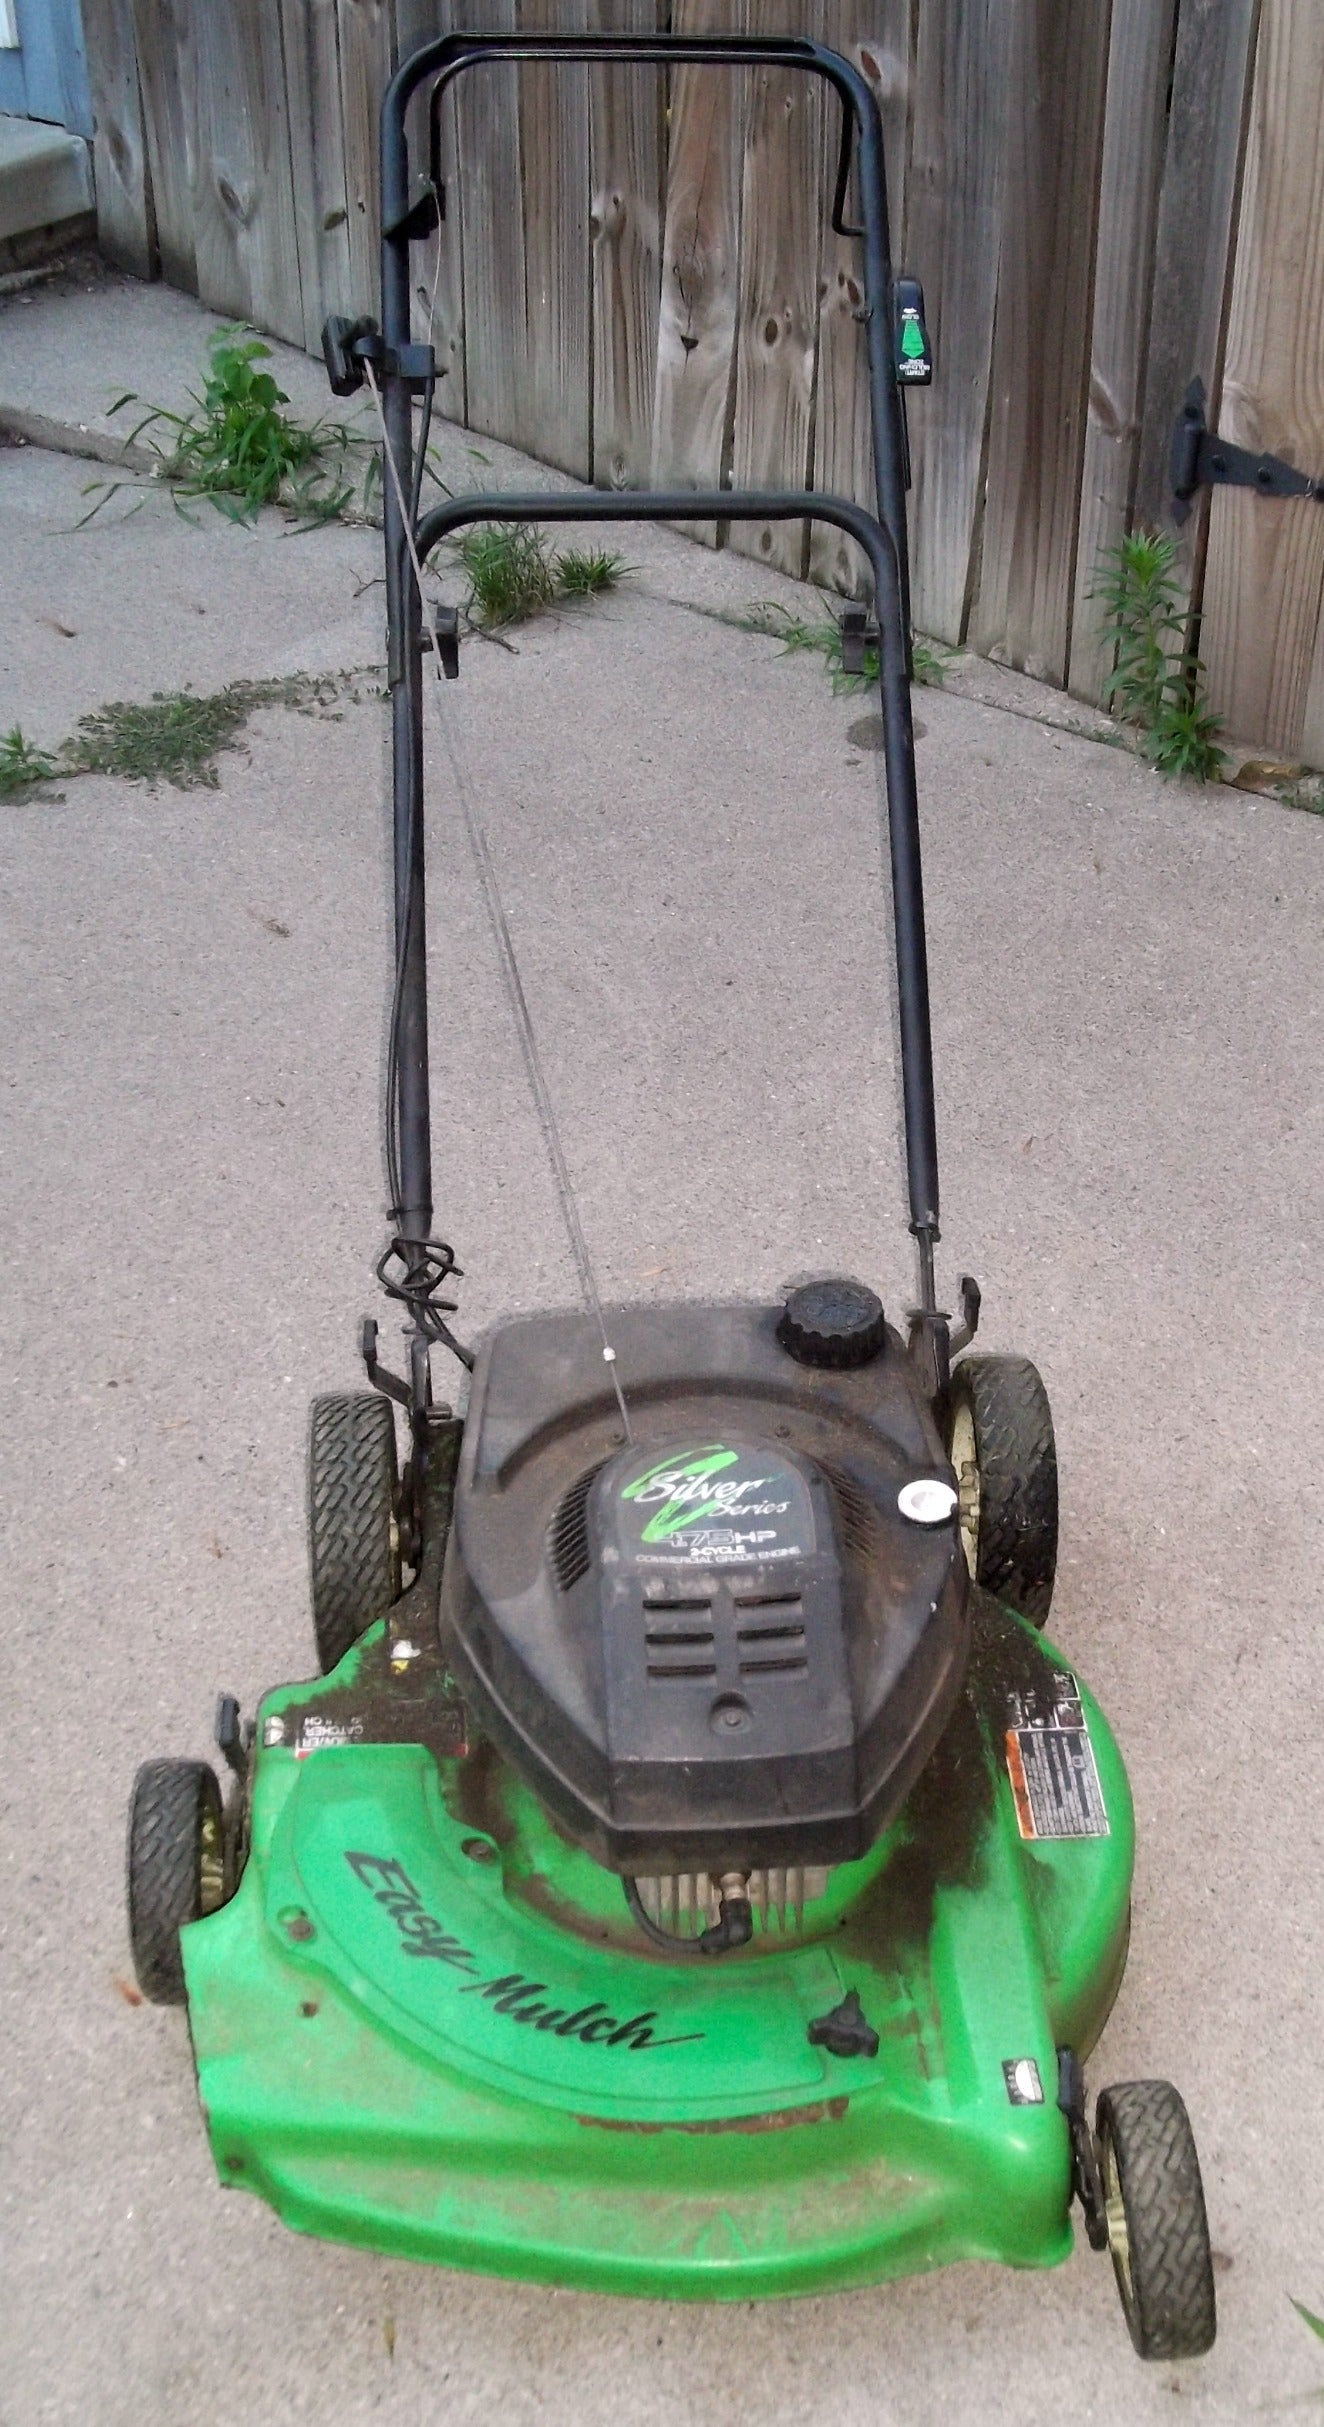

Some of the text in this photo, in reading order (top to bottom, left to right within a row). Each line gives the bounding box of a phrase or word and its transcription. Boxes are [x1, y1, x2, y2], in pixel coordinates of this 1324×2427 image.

[634, 1469, 766, 1502] Silver
[708, 1499, 791, 1517] Series
[636, 1553, 714, 1564] COMMERCIAL
[715, 1551, 757, 1563] GRADE
[690, 1545, 746, 1556] 2-CYCLE
[344, 1851, 706, 2051] Easy Mulch
